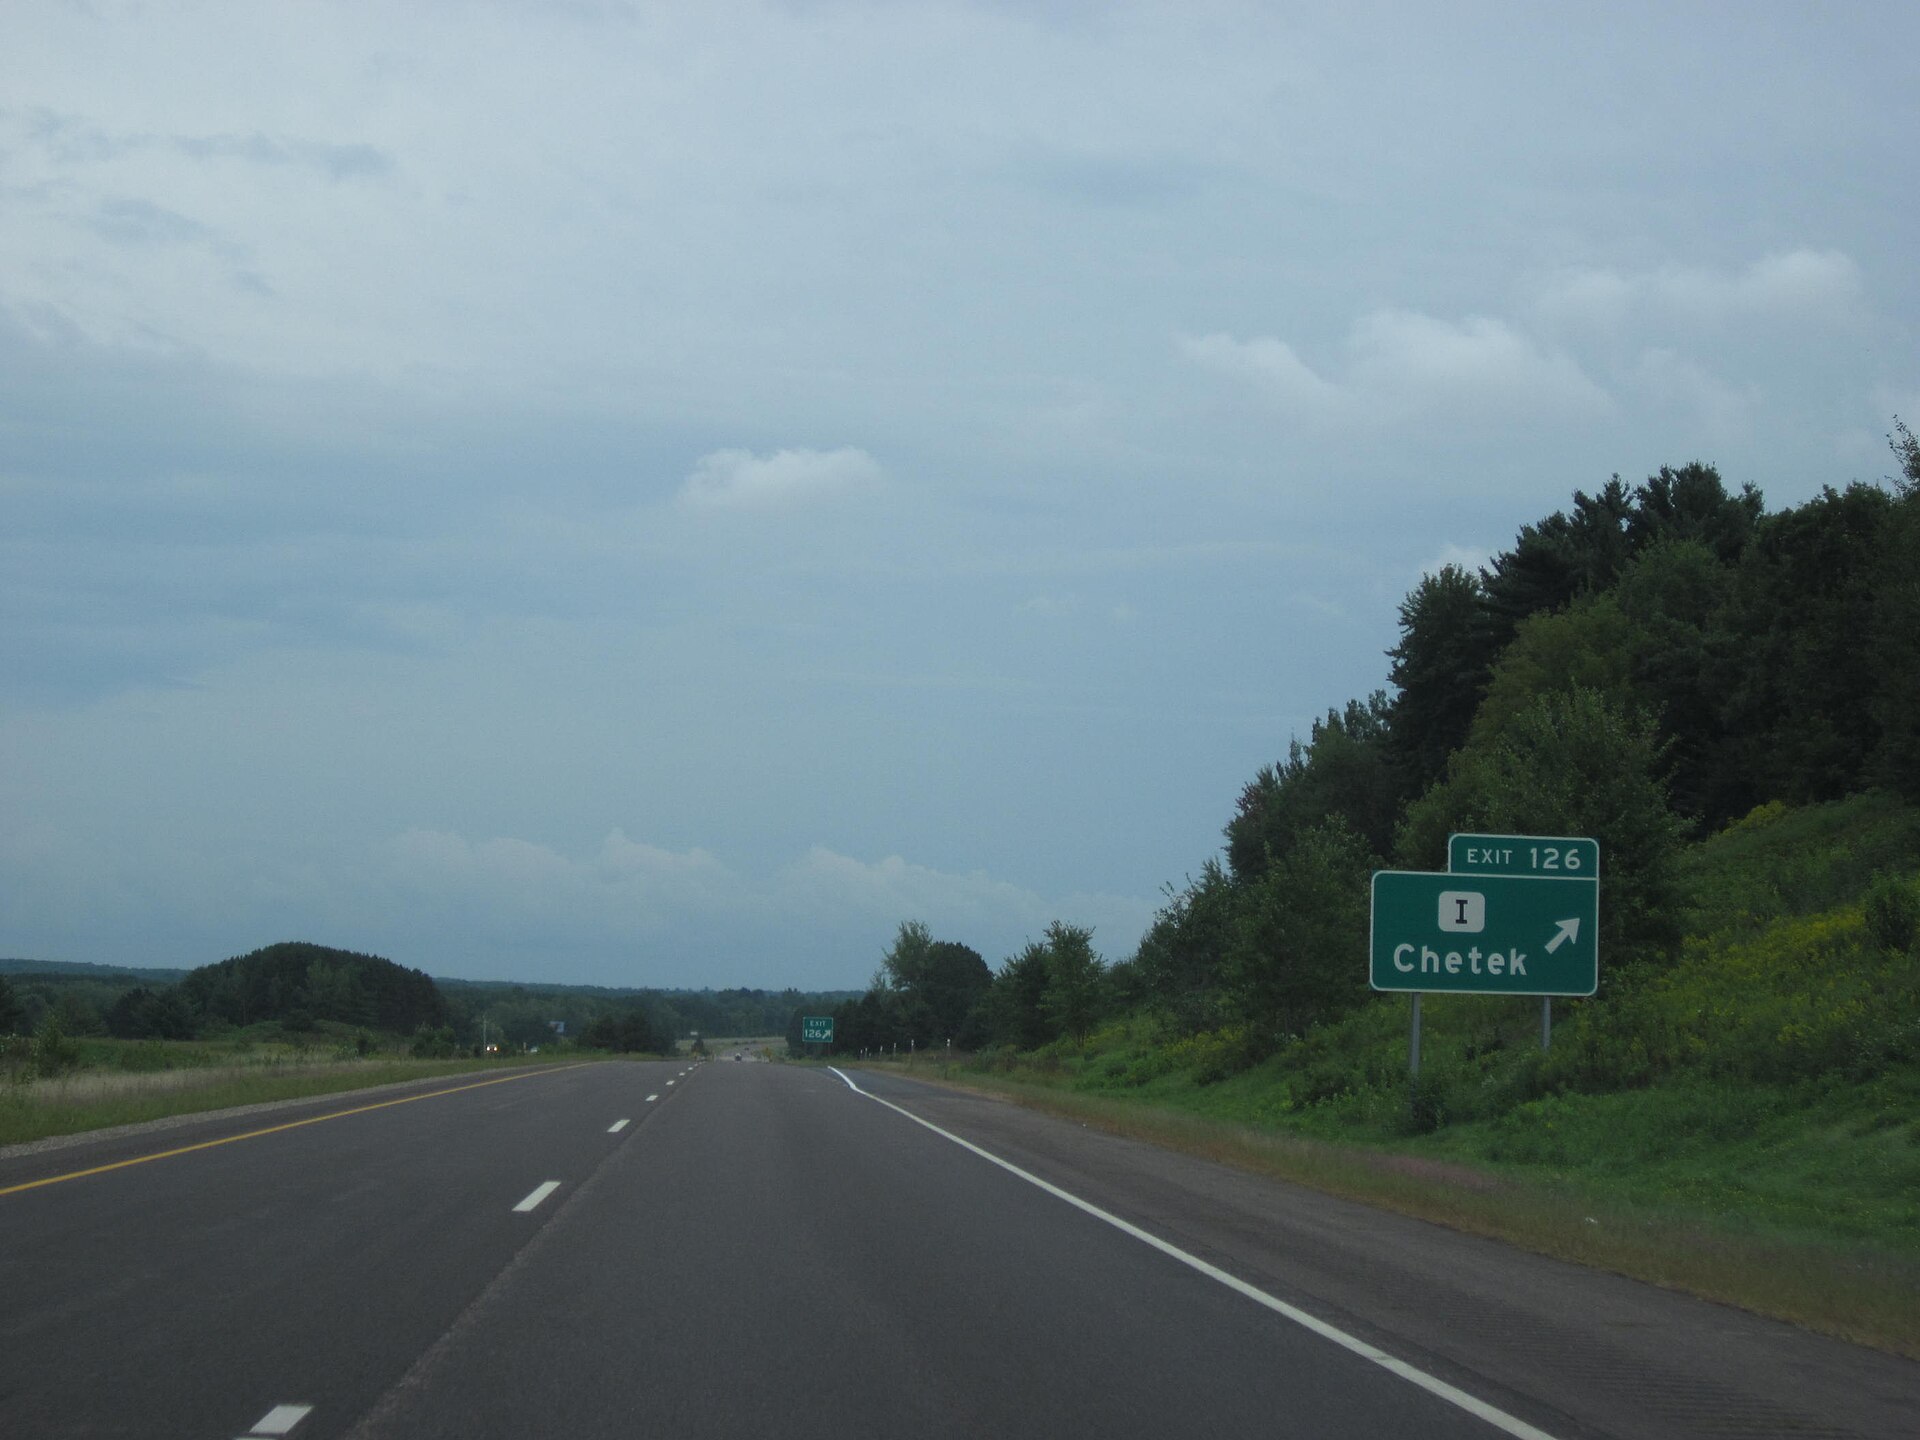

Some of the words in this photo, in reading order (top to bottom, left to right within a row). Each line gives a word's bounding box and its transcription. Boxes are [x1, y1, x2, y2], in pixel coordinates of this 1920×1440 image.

[1467, 848, 1513, 865] EXIT
[1530, 847, 1581, 870] 126
[1455, 899, 1468, 925] I
[1393, 943, 1528, 976] Chetek
[805, 1029, 822, 1038] 126
